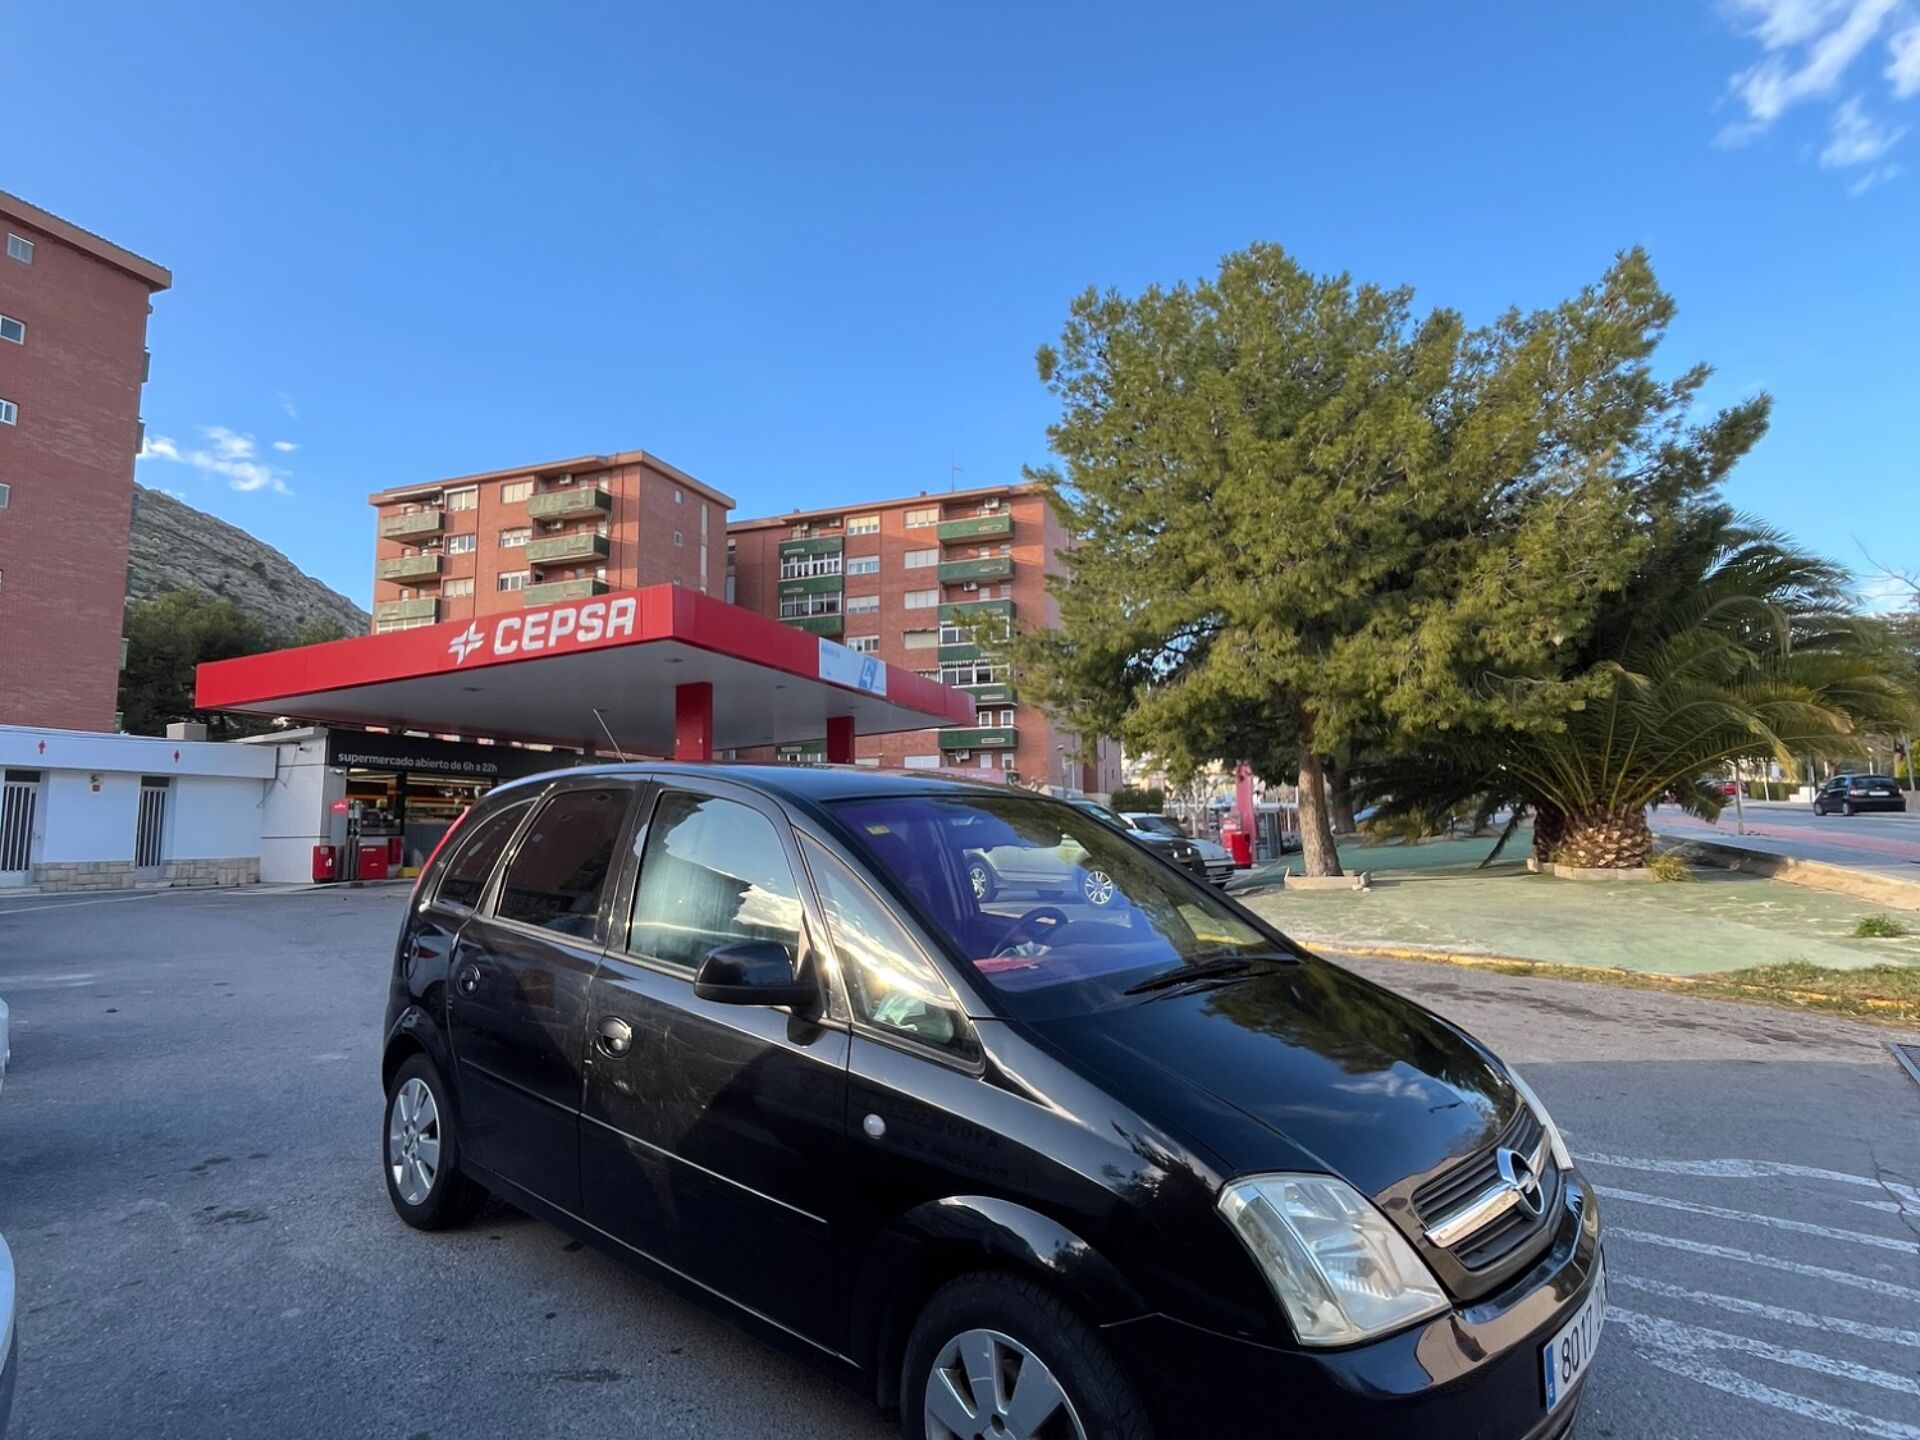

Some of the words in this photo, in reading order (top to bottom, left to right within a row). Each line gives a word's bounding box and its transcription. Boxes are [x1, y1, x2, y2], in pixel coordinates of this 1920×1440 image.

[494, 597, 637, 656] CEPSA
[338, 752, 413, 766] supermercado
[415, 759, 449, 770] abierto
[450, 762, 461, 770] de
[462, 762, 474, 771] 6h
[482, 764, 498, 772] 22h
[1562, 1303, 1592, 1384] 8017
